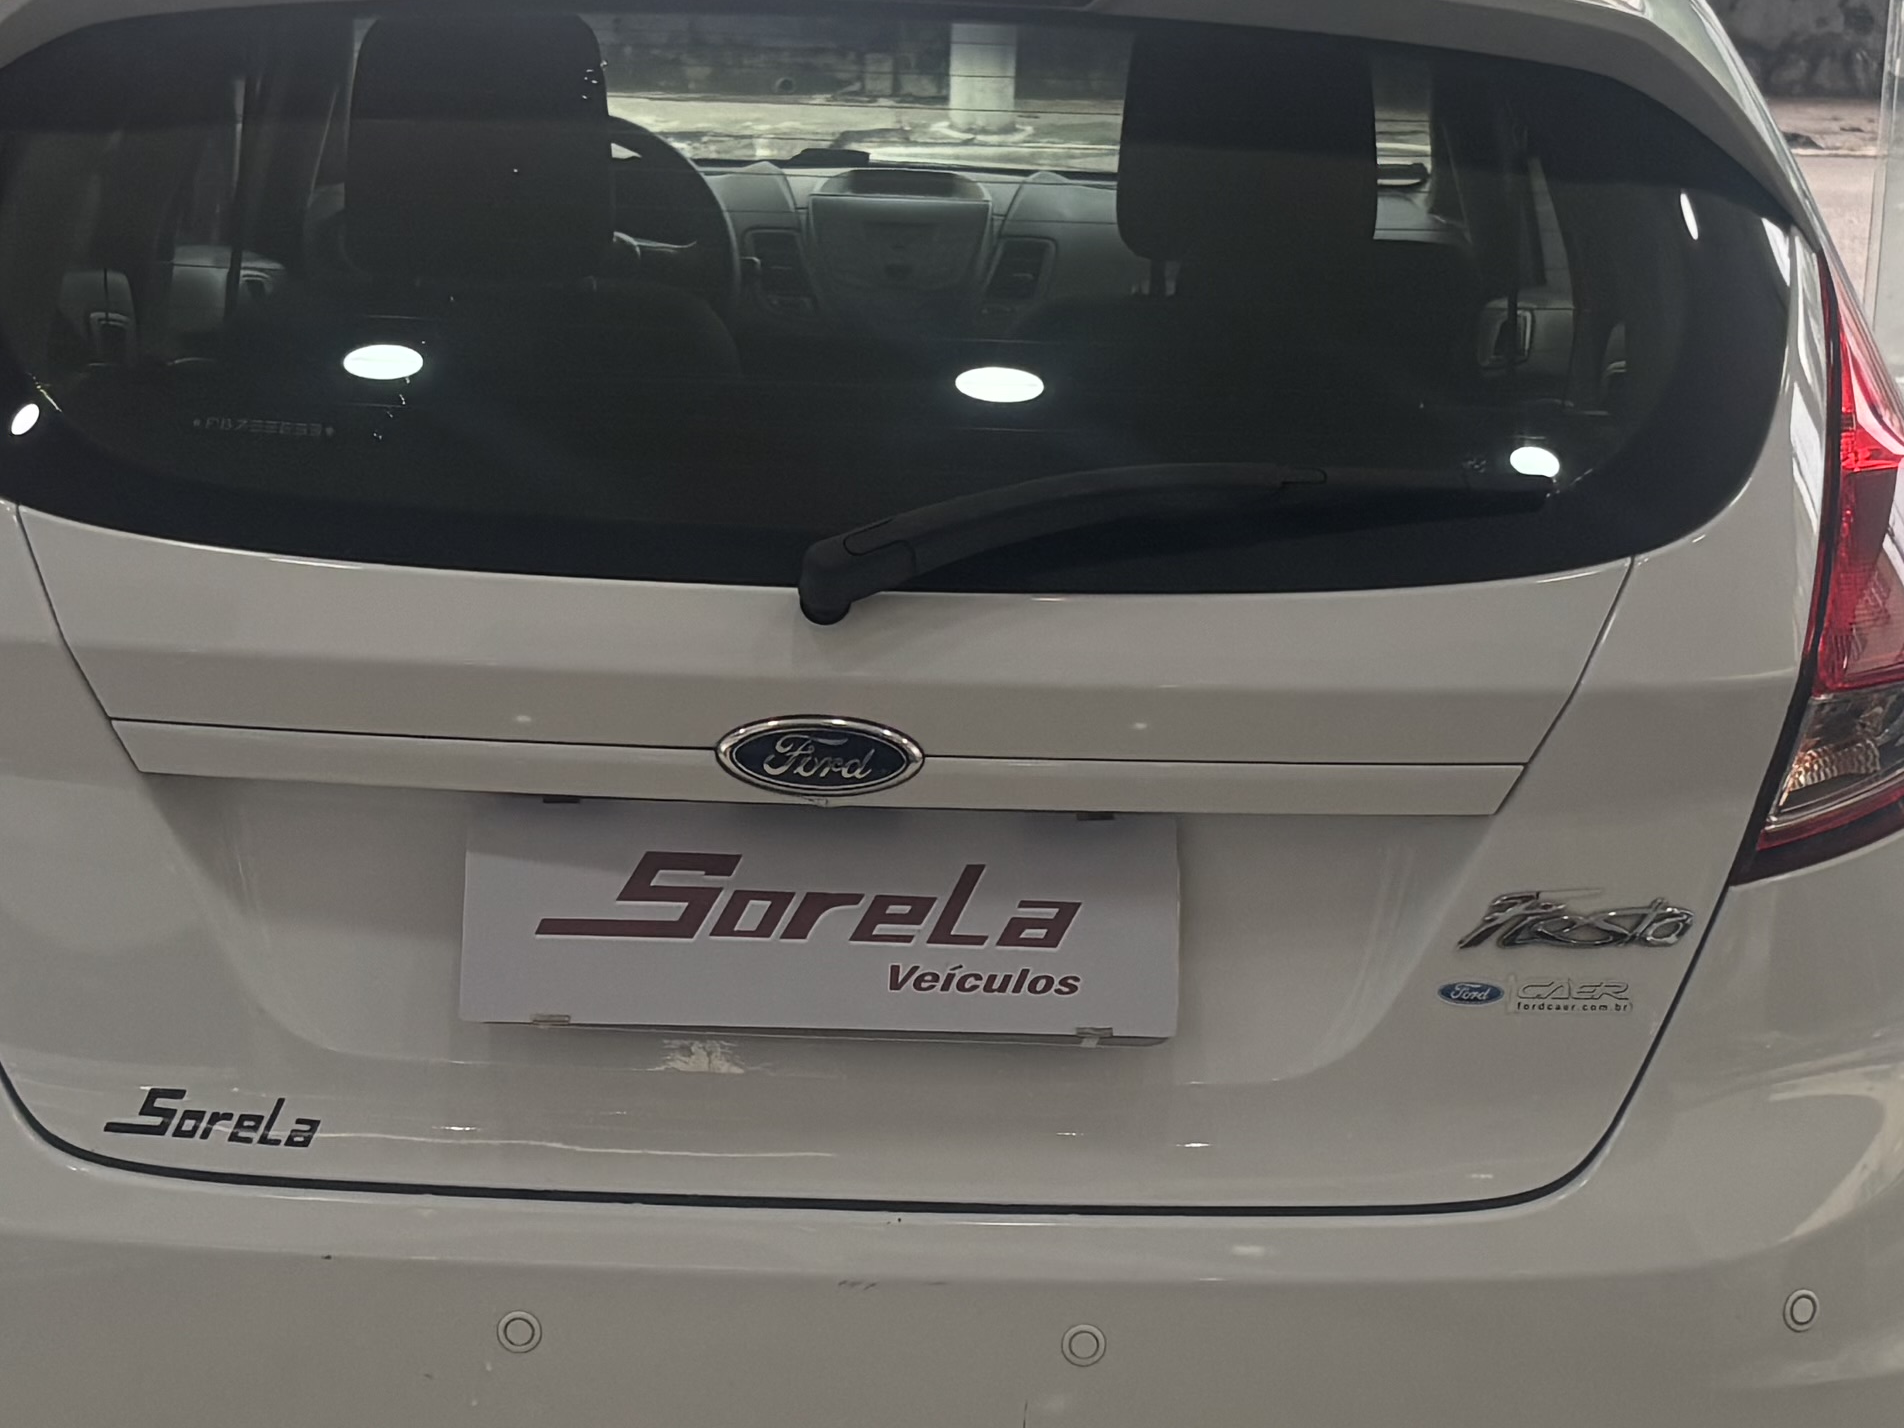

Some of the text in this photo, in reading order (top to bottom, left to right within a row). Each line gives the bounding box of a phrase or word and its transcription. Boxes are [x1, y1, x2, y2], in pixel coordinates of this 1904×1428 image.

[763, 733, 876, 780] Ford
[1456, 889, 1695, 949] Fiesta
[886, 963, 1082, 997] Veículos
[1517, 980, 1630, 1000] CAER
[1516, 1001, 1630, 1013] fordcaer.com.br
